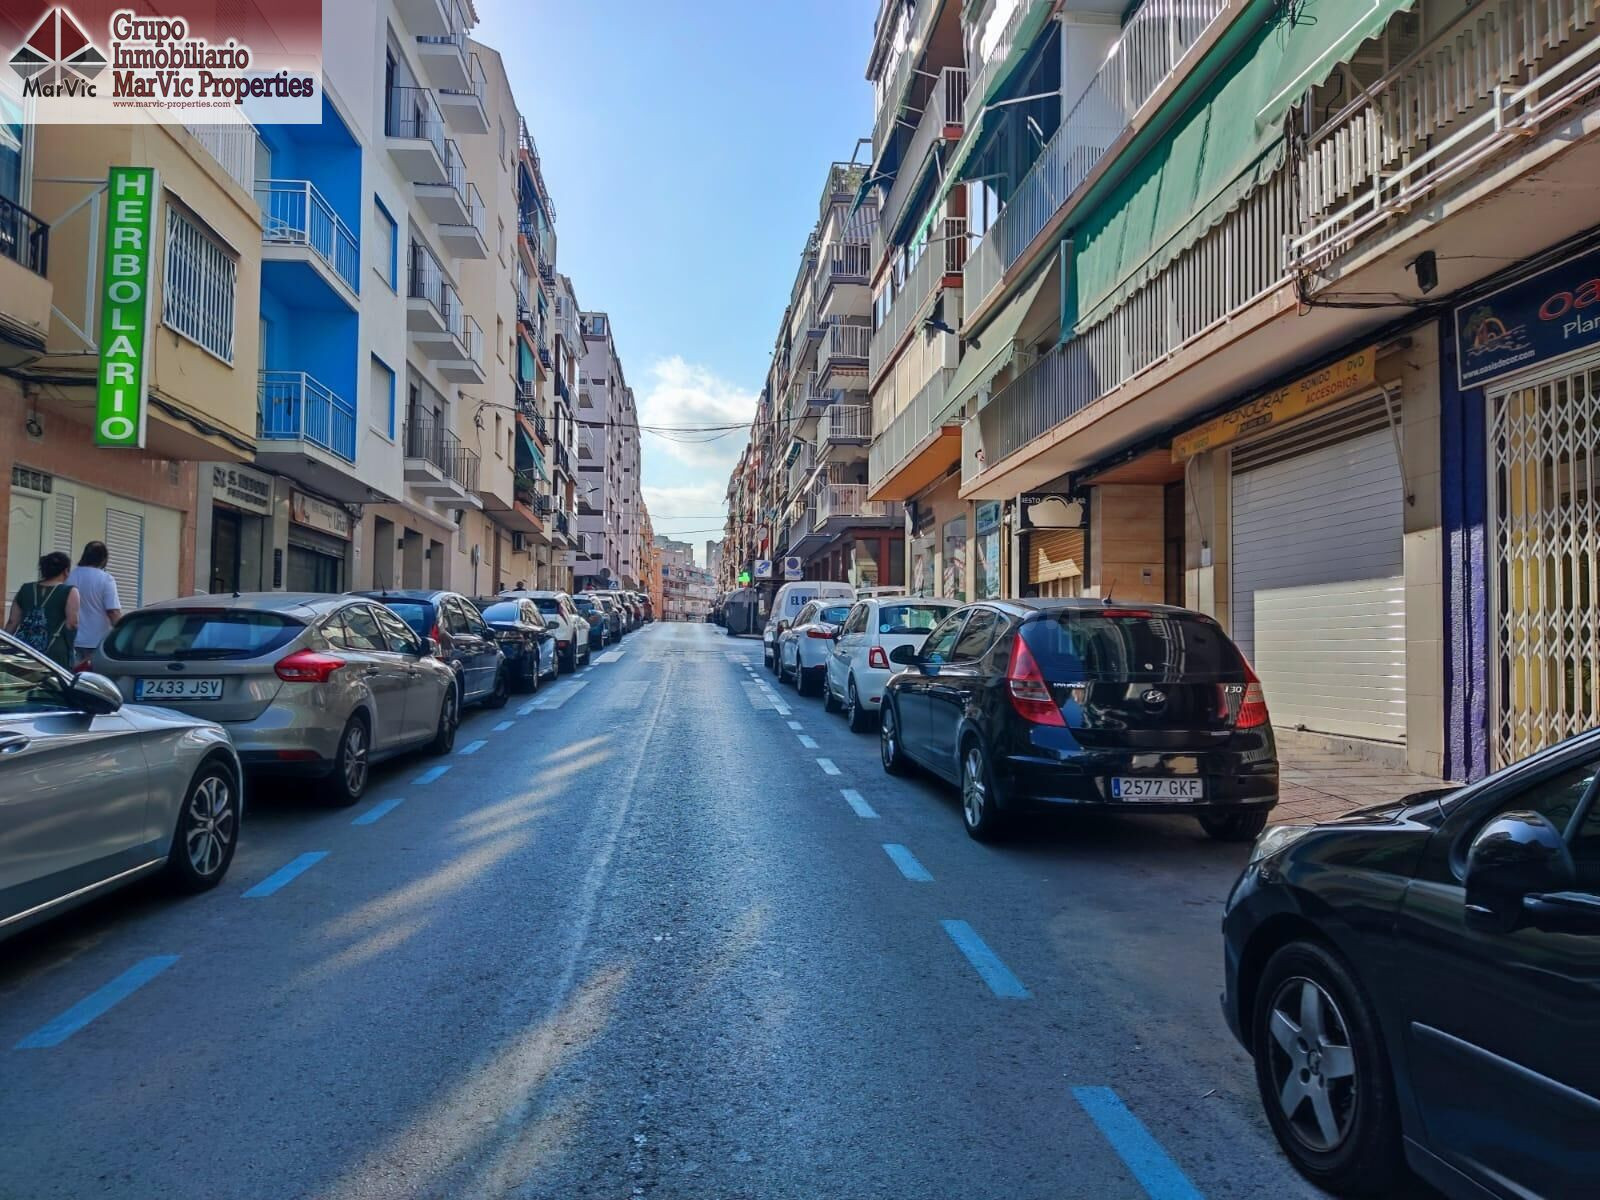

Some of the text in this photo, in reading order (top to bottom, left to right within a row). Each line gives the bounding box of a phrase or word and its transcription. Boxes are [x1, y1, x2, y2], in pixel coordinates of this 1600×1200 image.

[101, 173, 146, 440] HERBOLARIO
[1300, 369, 1331, 393] SONIDO
[1305, 373, 1359, 405] ACCESORIOS
[146, 681, 219, 694] 2433 JSV
[1123, 780, 1198, 796] 2577 GKF
